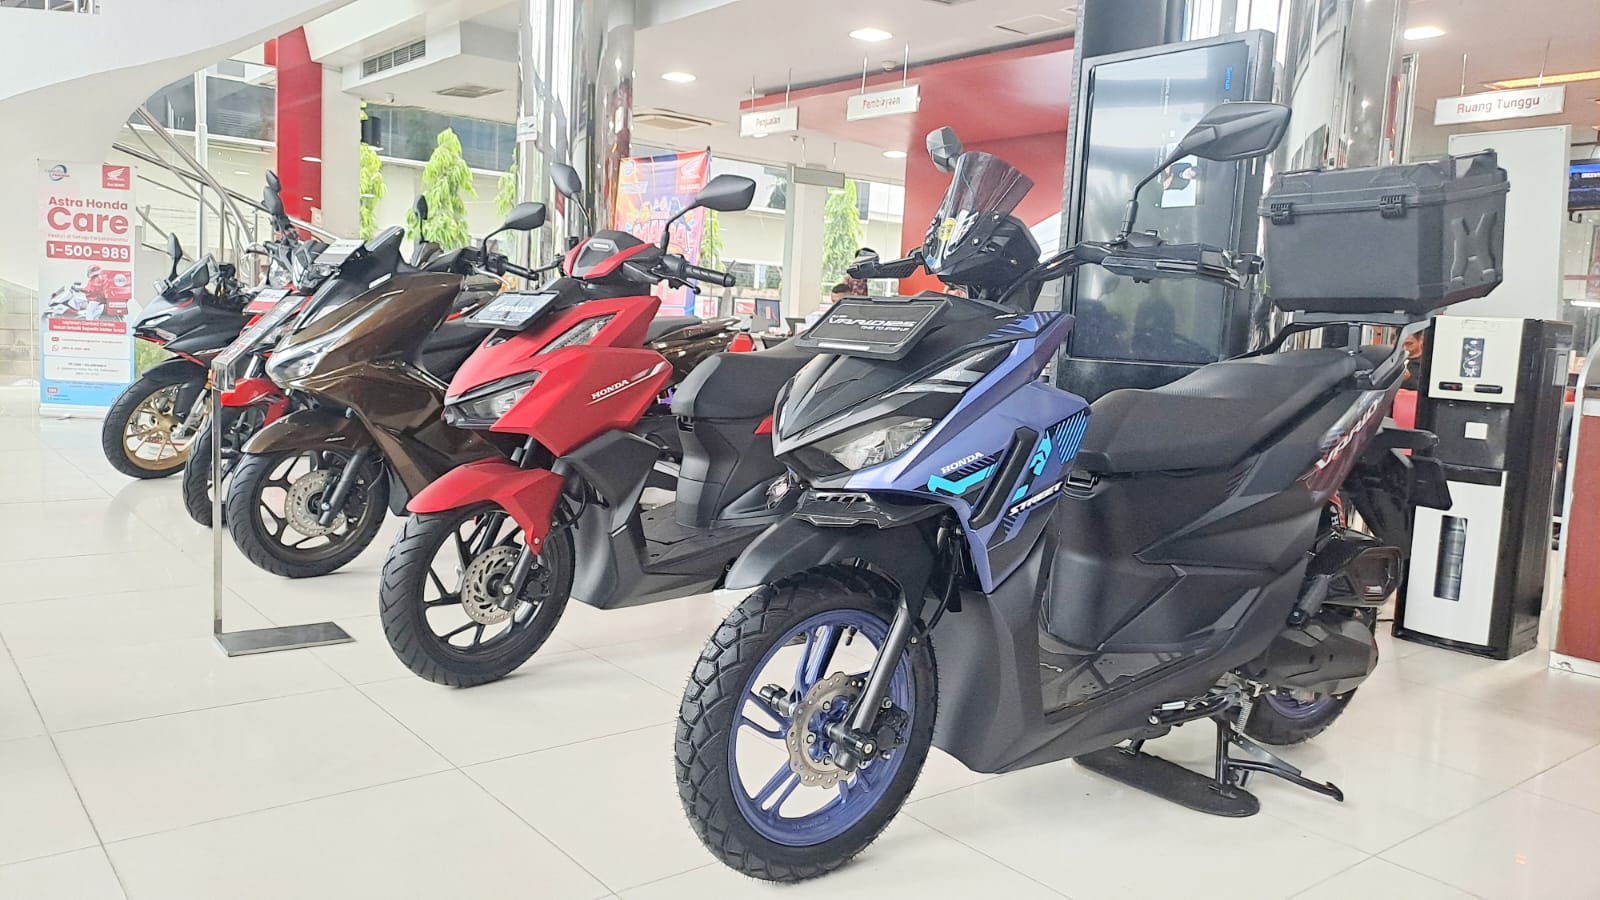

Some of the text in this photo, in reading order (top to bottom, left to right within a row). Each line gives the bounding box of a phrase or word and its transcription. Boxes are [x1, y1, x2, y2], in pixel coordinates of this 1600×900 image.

[863, 96, 901, 110] Pembiayaan
[1456, 96, 1540, 113] Ruang Tunggu
[48, 196, 128, 210] Astra Honda
[47, 206, 129, 234] Care
[49, 243, 129, 260] 1-500-989
[591, 379, 630, 399] HONDA
[940, 451, 985, 475] HONDA
[1008, 481, 1064, 517] STREET
